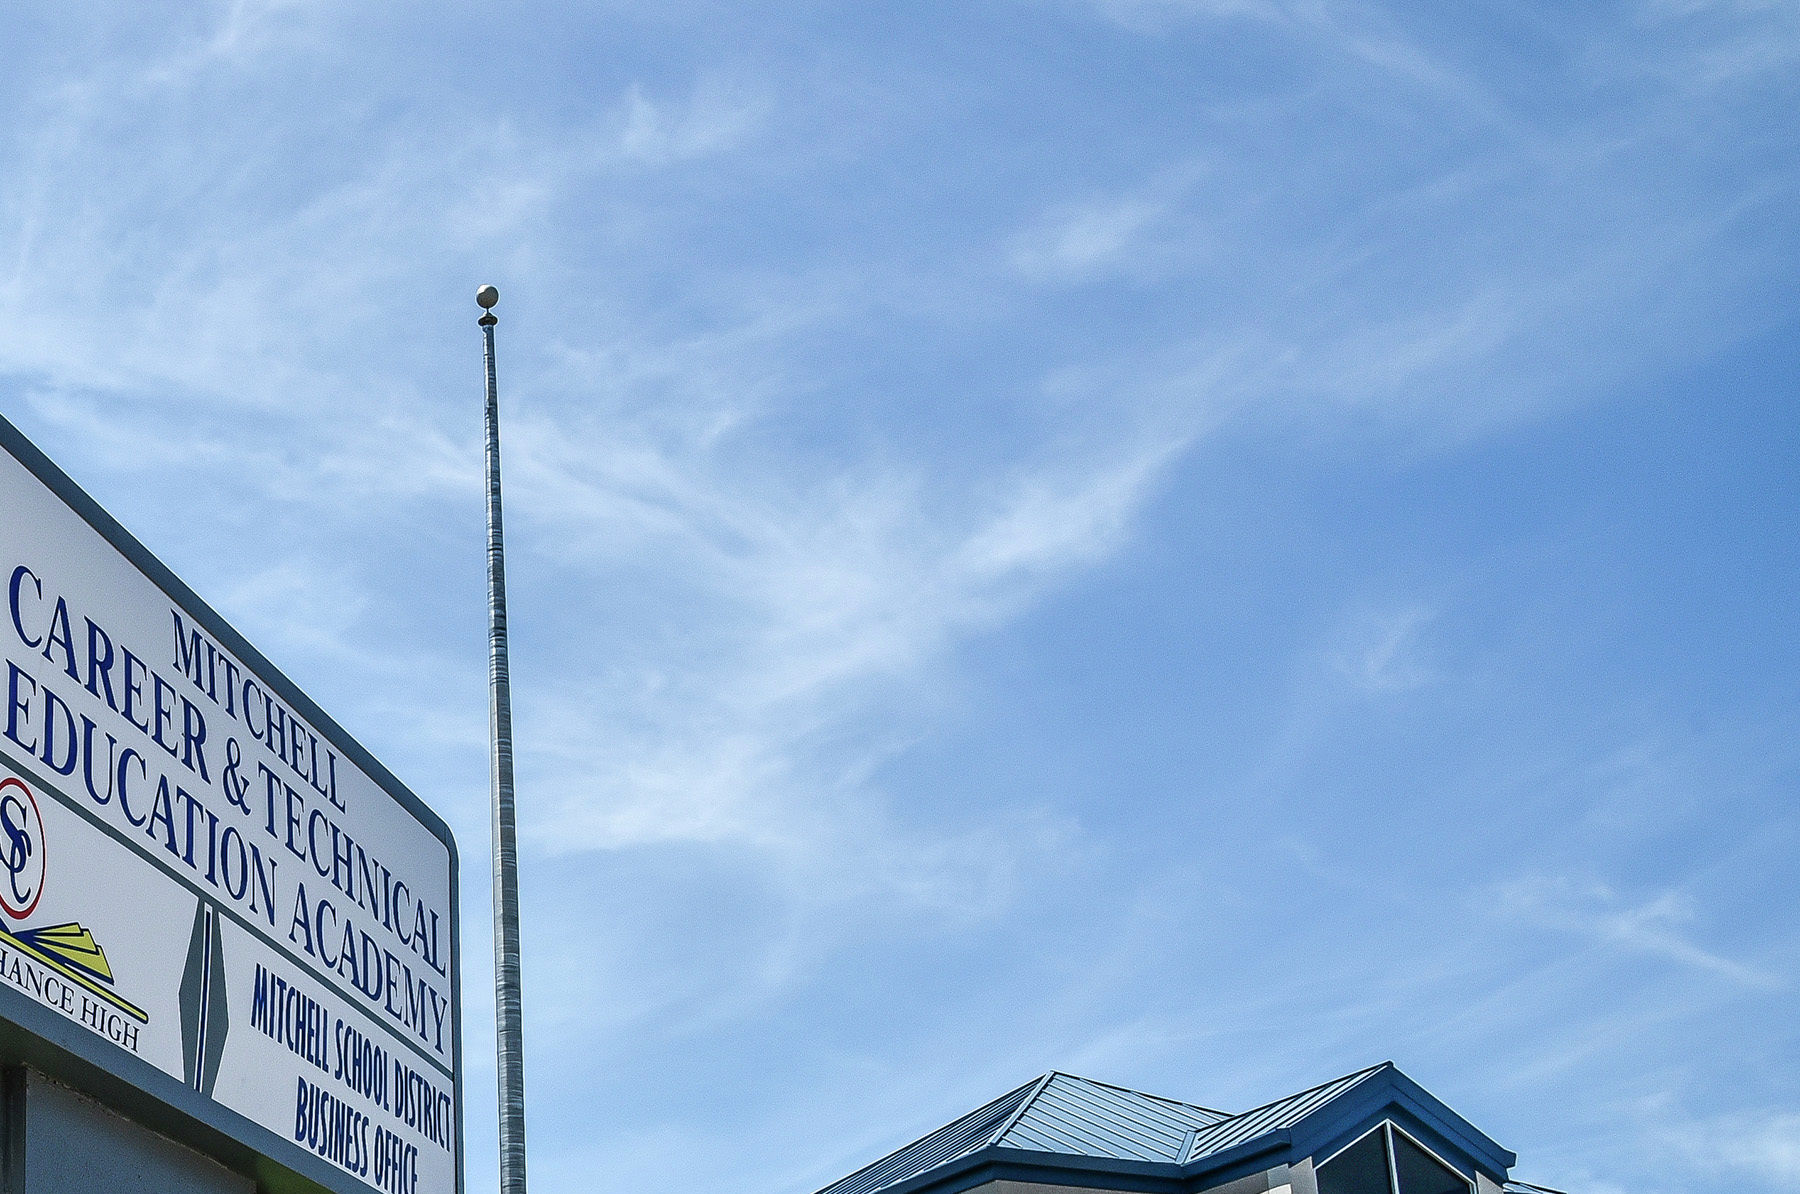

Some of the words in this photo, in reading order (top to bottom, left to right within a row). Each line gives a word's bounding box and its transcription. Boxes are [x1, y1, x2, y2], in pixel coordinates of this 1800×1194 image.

[9, 565, 212, 786] CAREER
[222, 737, 252, 816] &
[258, 761, 446, 978] TECHNICAL
[170, 608, 346, 814] MITCHELL
[3, 659, 278, 928] EDUCATION
[289, 882, 448, 1055] ACADEMY
[80, 996, 140, 1053] HIGH
[251, 963, 329, 1074] MITCHELL
[335, 1019, 389, 1112] SCHOOL
[394, 1058, 451, 1152] DISTRICT
[294, 1075, 369, 1177] BUSINESS
